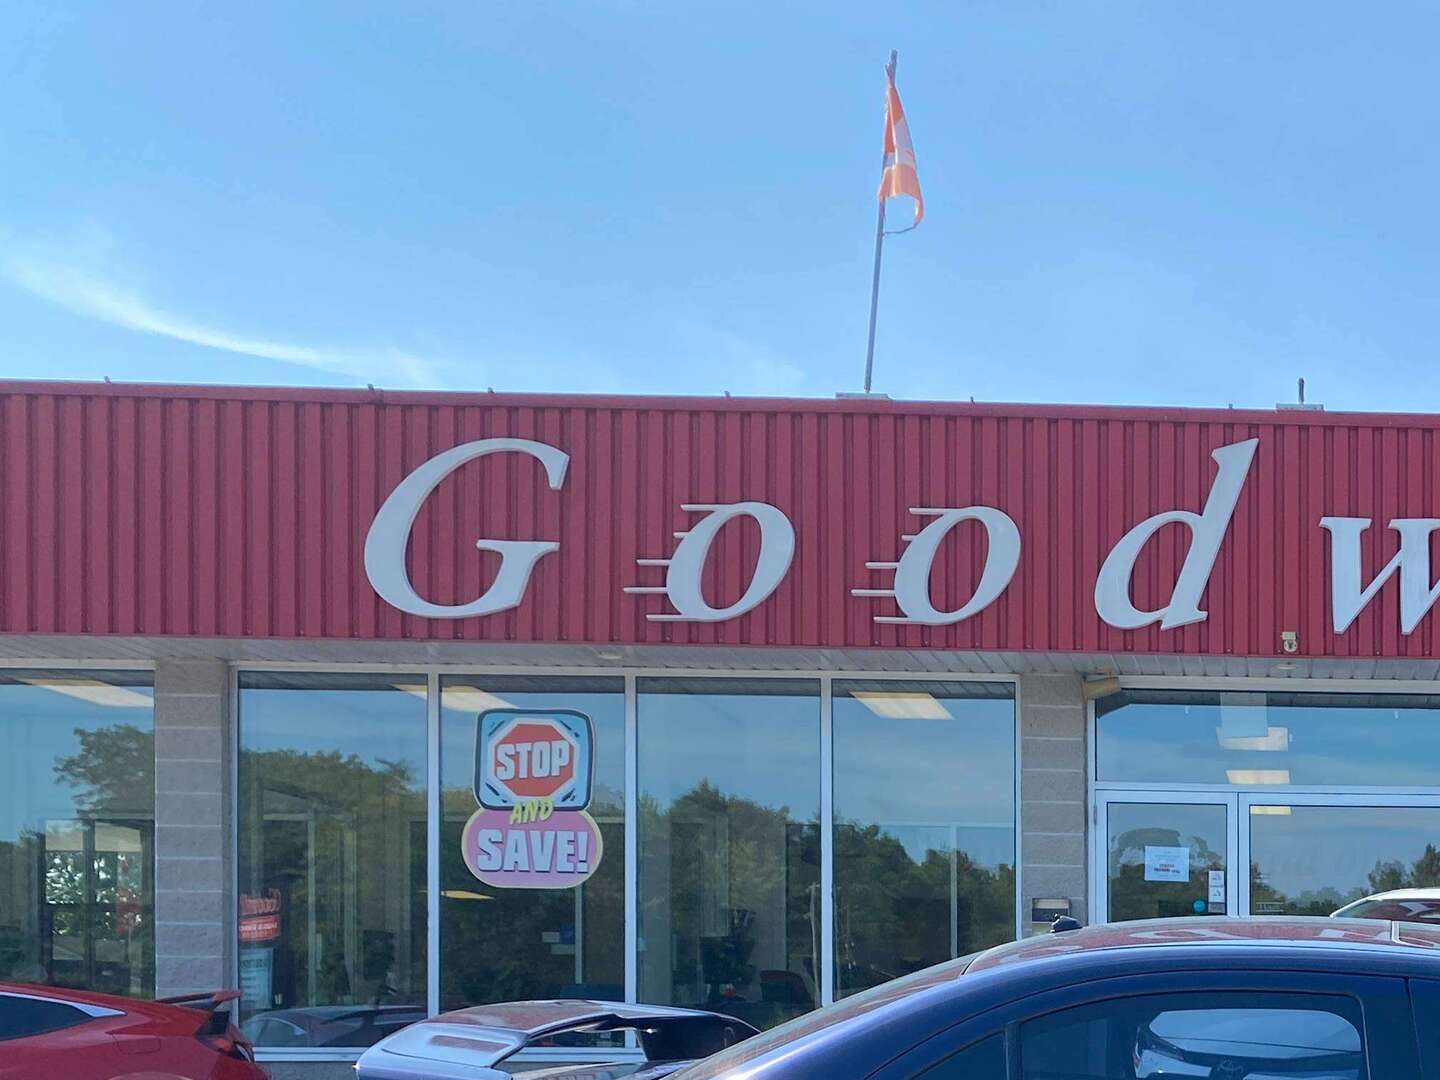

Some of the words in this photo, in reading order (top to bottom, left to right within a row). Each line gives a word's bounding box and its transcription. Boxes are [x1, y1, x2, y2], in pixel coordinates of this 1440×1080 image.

[496, 740, 571, 780] STOP
[510, 800, 554, 825] AND
[477, 828, 589, 874] SAVE!
